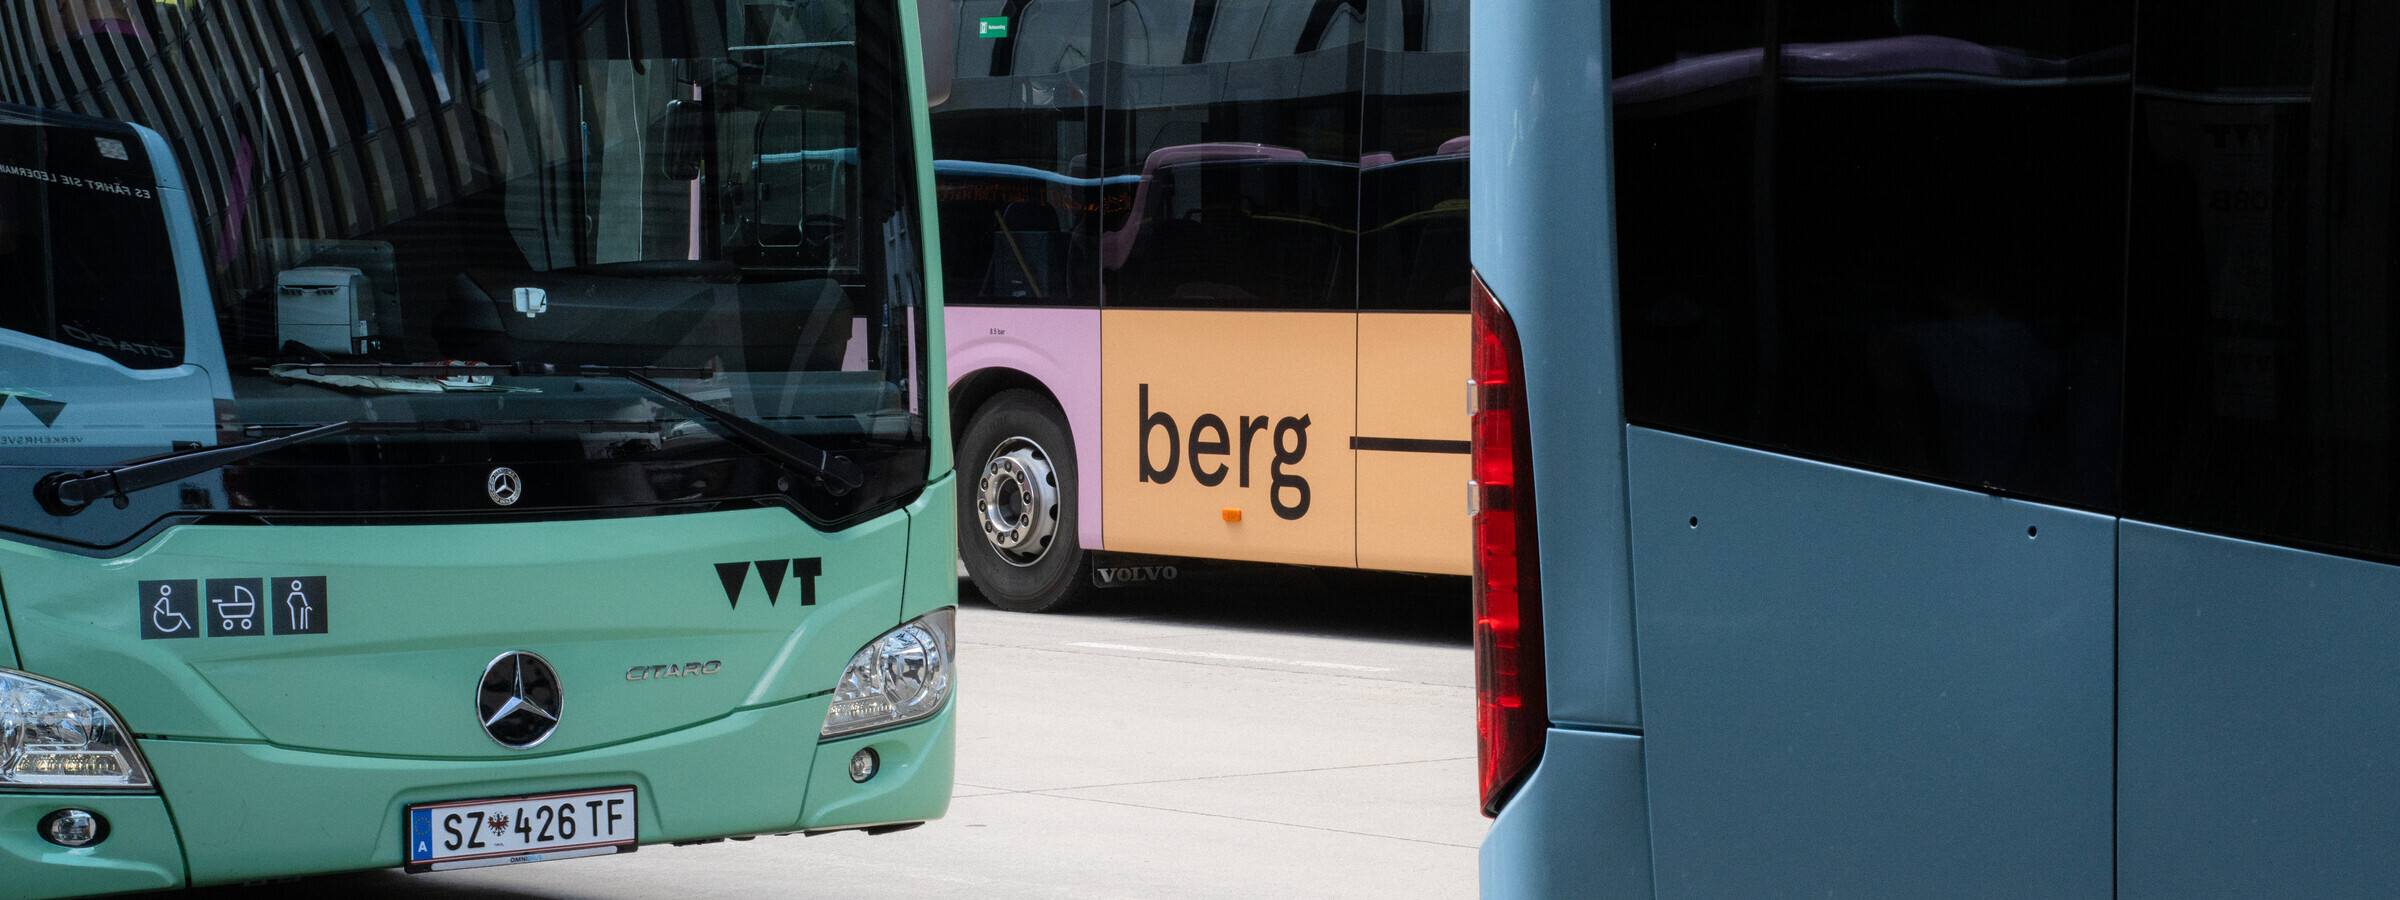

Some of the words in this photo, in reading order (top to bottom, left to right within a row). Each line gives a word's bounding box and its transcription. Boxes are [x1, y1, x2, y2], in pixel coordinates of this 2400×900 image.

[1138, 383, 1312, 520] berg
[713, 557, 822, 611] VVT
[1097, 566, 1178, 583] VOLVO
[626, 660, 722, 681] CITARO
[443, 811, 486, 851] SZ
[514, 803, 576, 844] 426
[586, 799, 624, 836] TF
[418, 841, 427, 853] A
